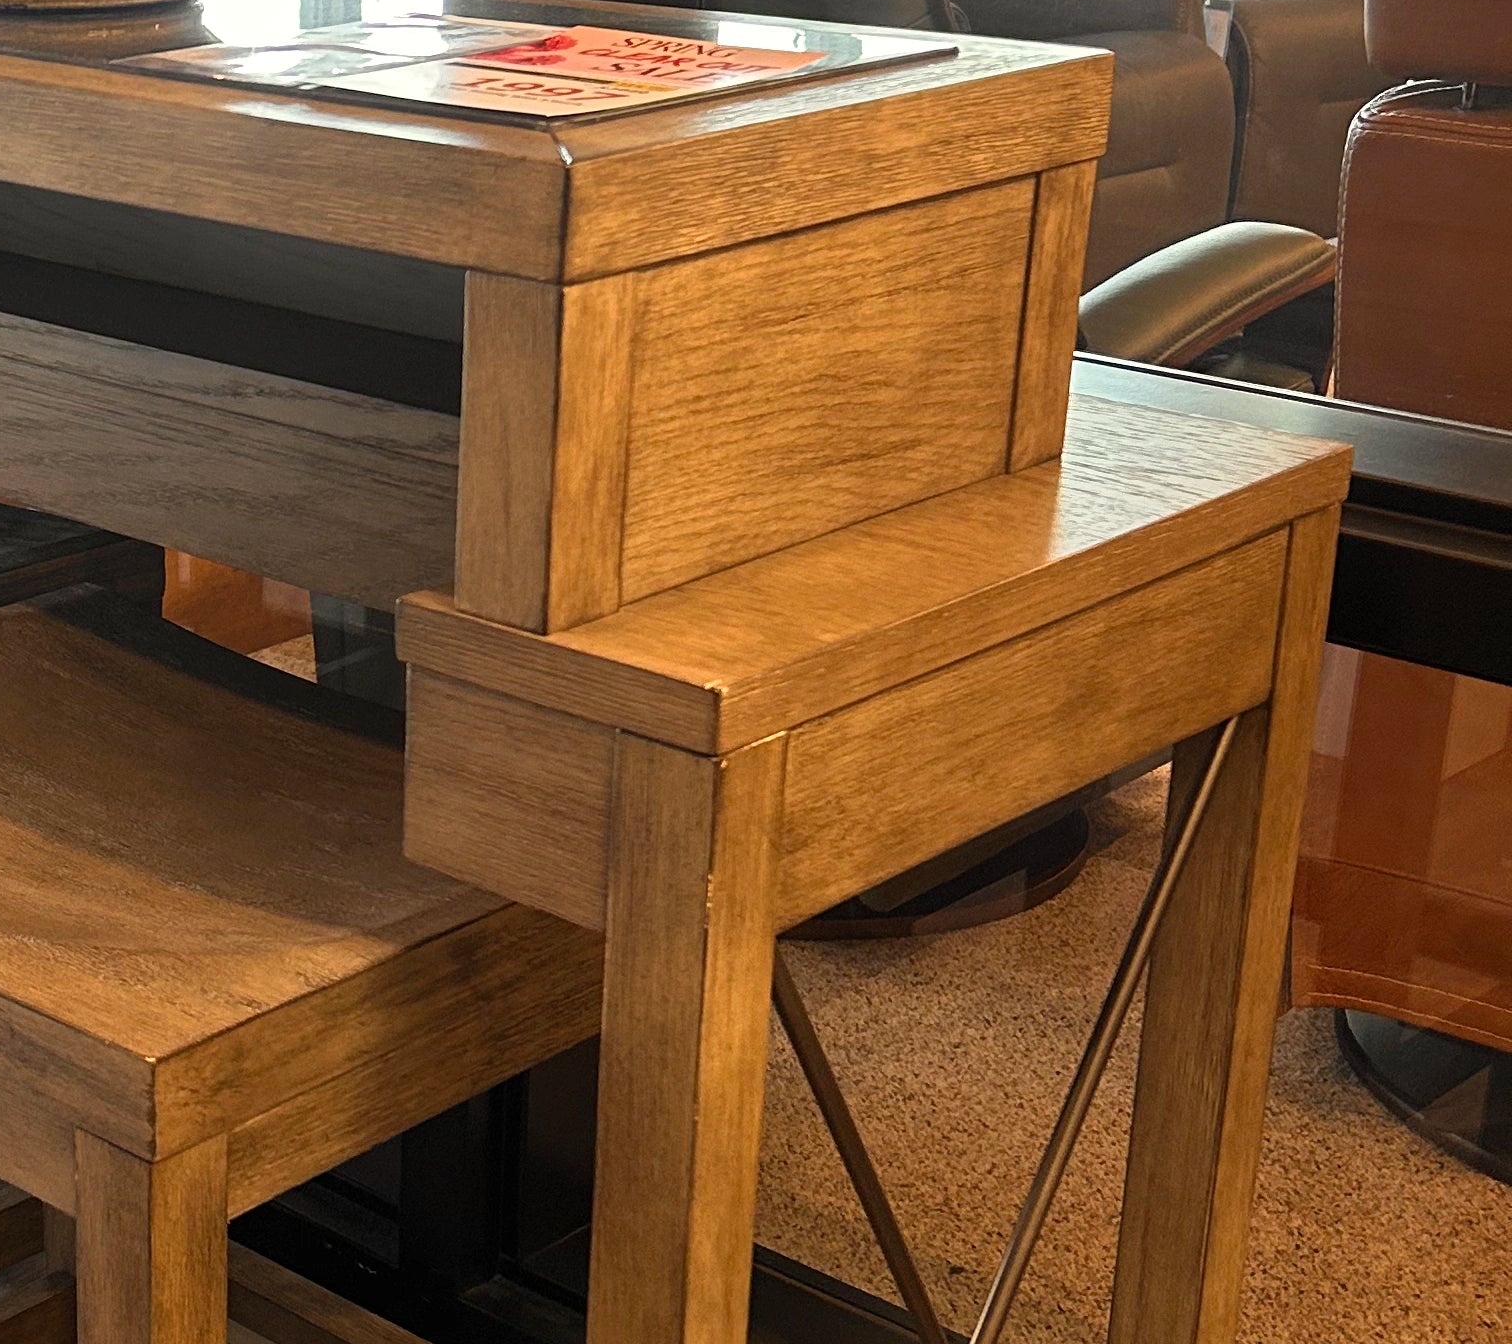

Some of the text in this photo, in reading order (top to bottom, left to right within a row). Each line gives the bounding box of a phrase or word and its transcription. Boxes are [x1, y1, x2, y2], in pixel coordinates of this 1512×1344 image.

[612, 36, 742, 58] SPRING
[579, 48, 783, 74] CLEAR OUT
[591, 62, 736, 86] SALE
[450, 77, 630, 102] 1997
